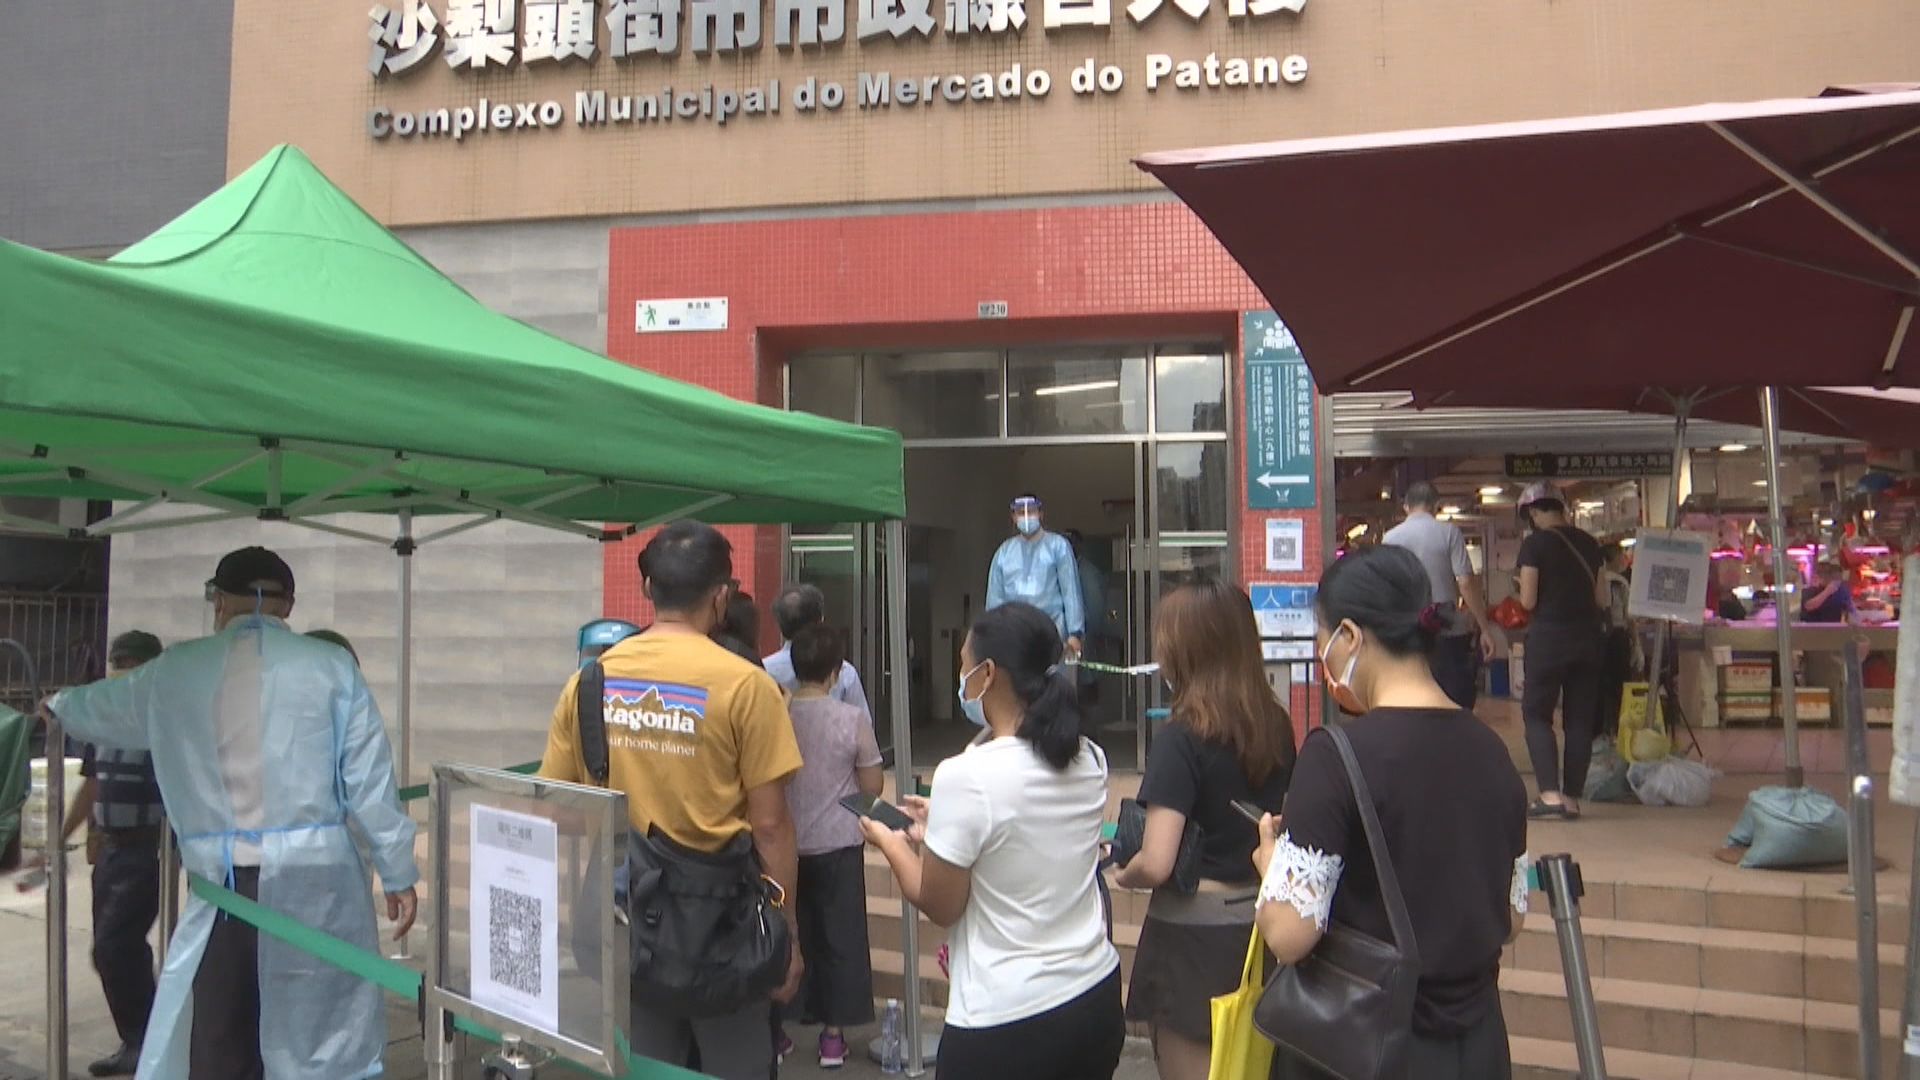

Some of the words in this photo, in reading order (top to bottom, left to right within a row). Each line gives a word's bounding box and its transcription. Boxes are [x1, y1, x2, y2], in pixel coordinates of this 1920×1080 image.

[367, 98, 563, 139] Complexo
[574, 79, 781, 126] Municipal
[793, 76, 845, 112] do
[857, 62, 1052, 108] Mercado
[1070, 57, 1124, 95] do
[1146, 50, 1309, 94] Patane
[609, 736, 623, 748] ur
[625, 736, 659, 751] home
[661, 741, 696, 758] planet
